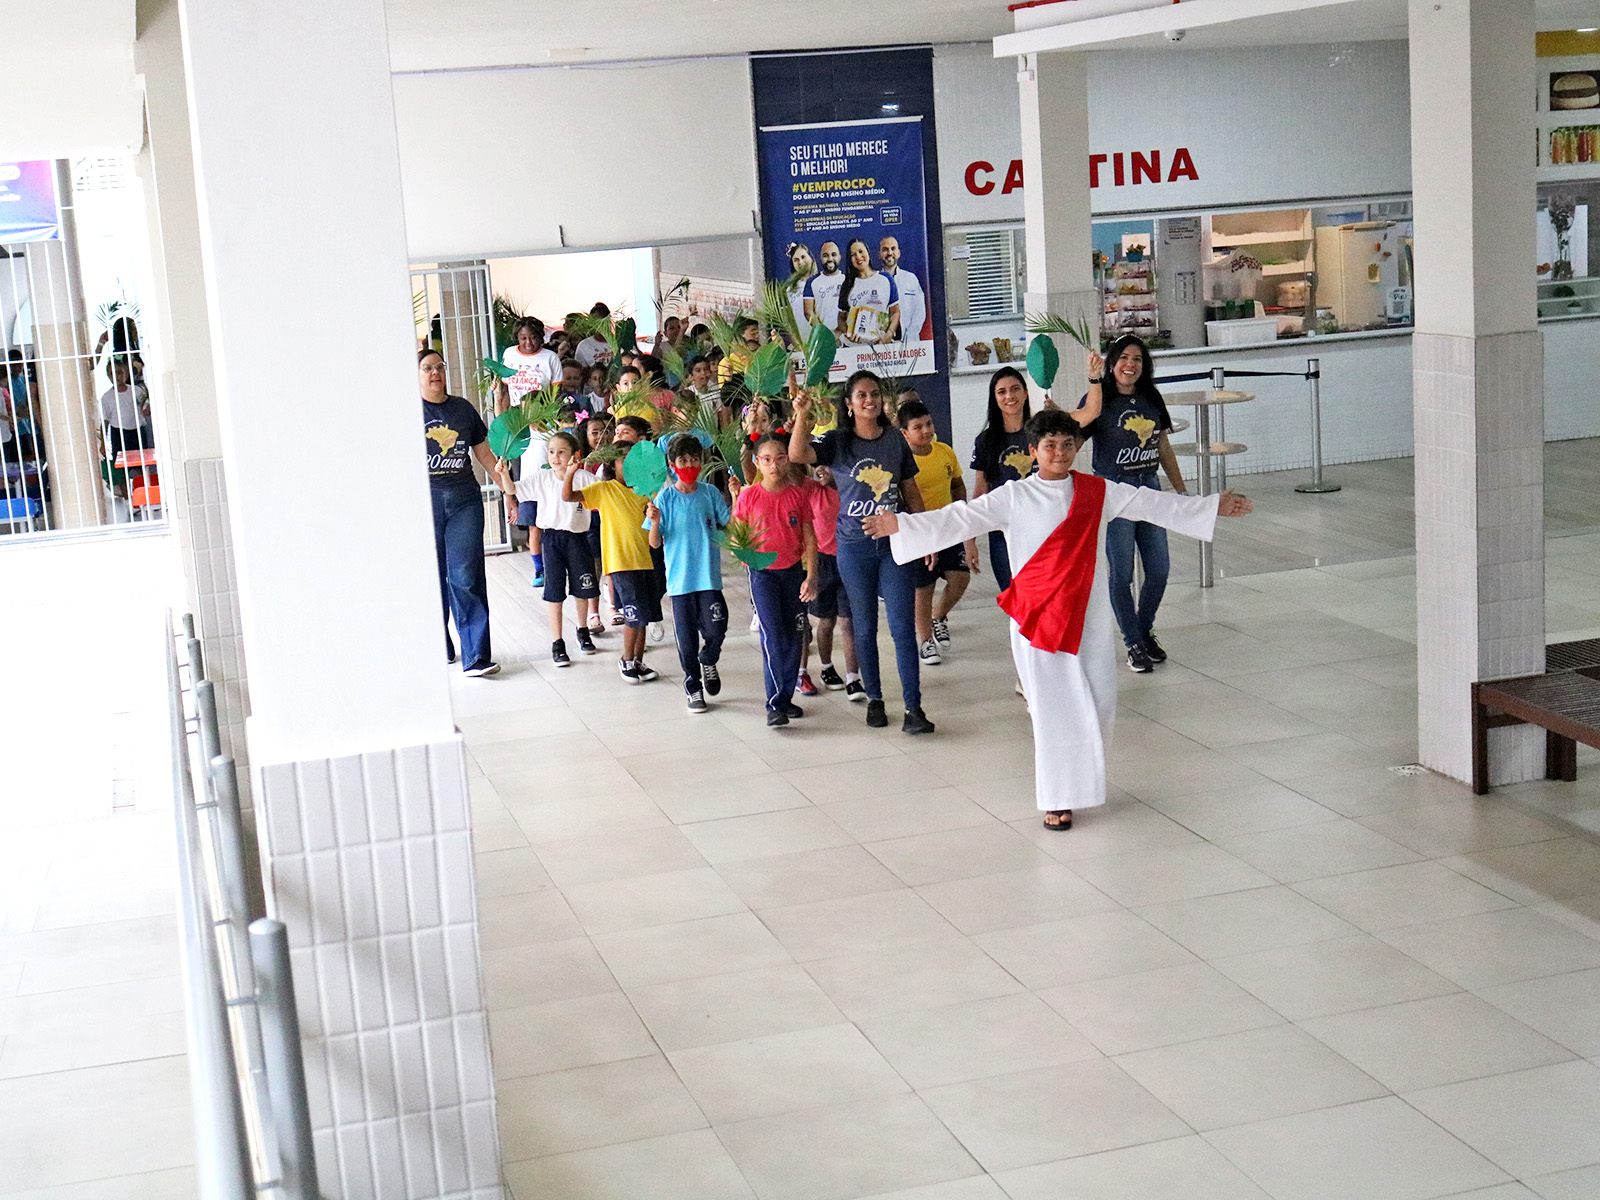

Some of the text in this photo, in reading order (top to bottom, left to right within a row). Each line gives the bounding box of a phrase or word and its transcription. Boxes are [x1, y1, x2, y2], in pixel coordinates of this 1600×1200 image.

[790, 140, 888, 160] SEU FILHO MERECE
[790, 159, 848, 176] O MELHOR!
[964, 147, 1200, 196] CATINA
[792, 178, 876, 192] #VEMPROCPO
[893, 351, 897, 359] E
[899, 348, 926, 358] VALORES
[1116, 446, 1140, 464] 120
[848, 500, 874, 516] 120
